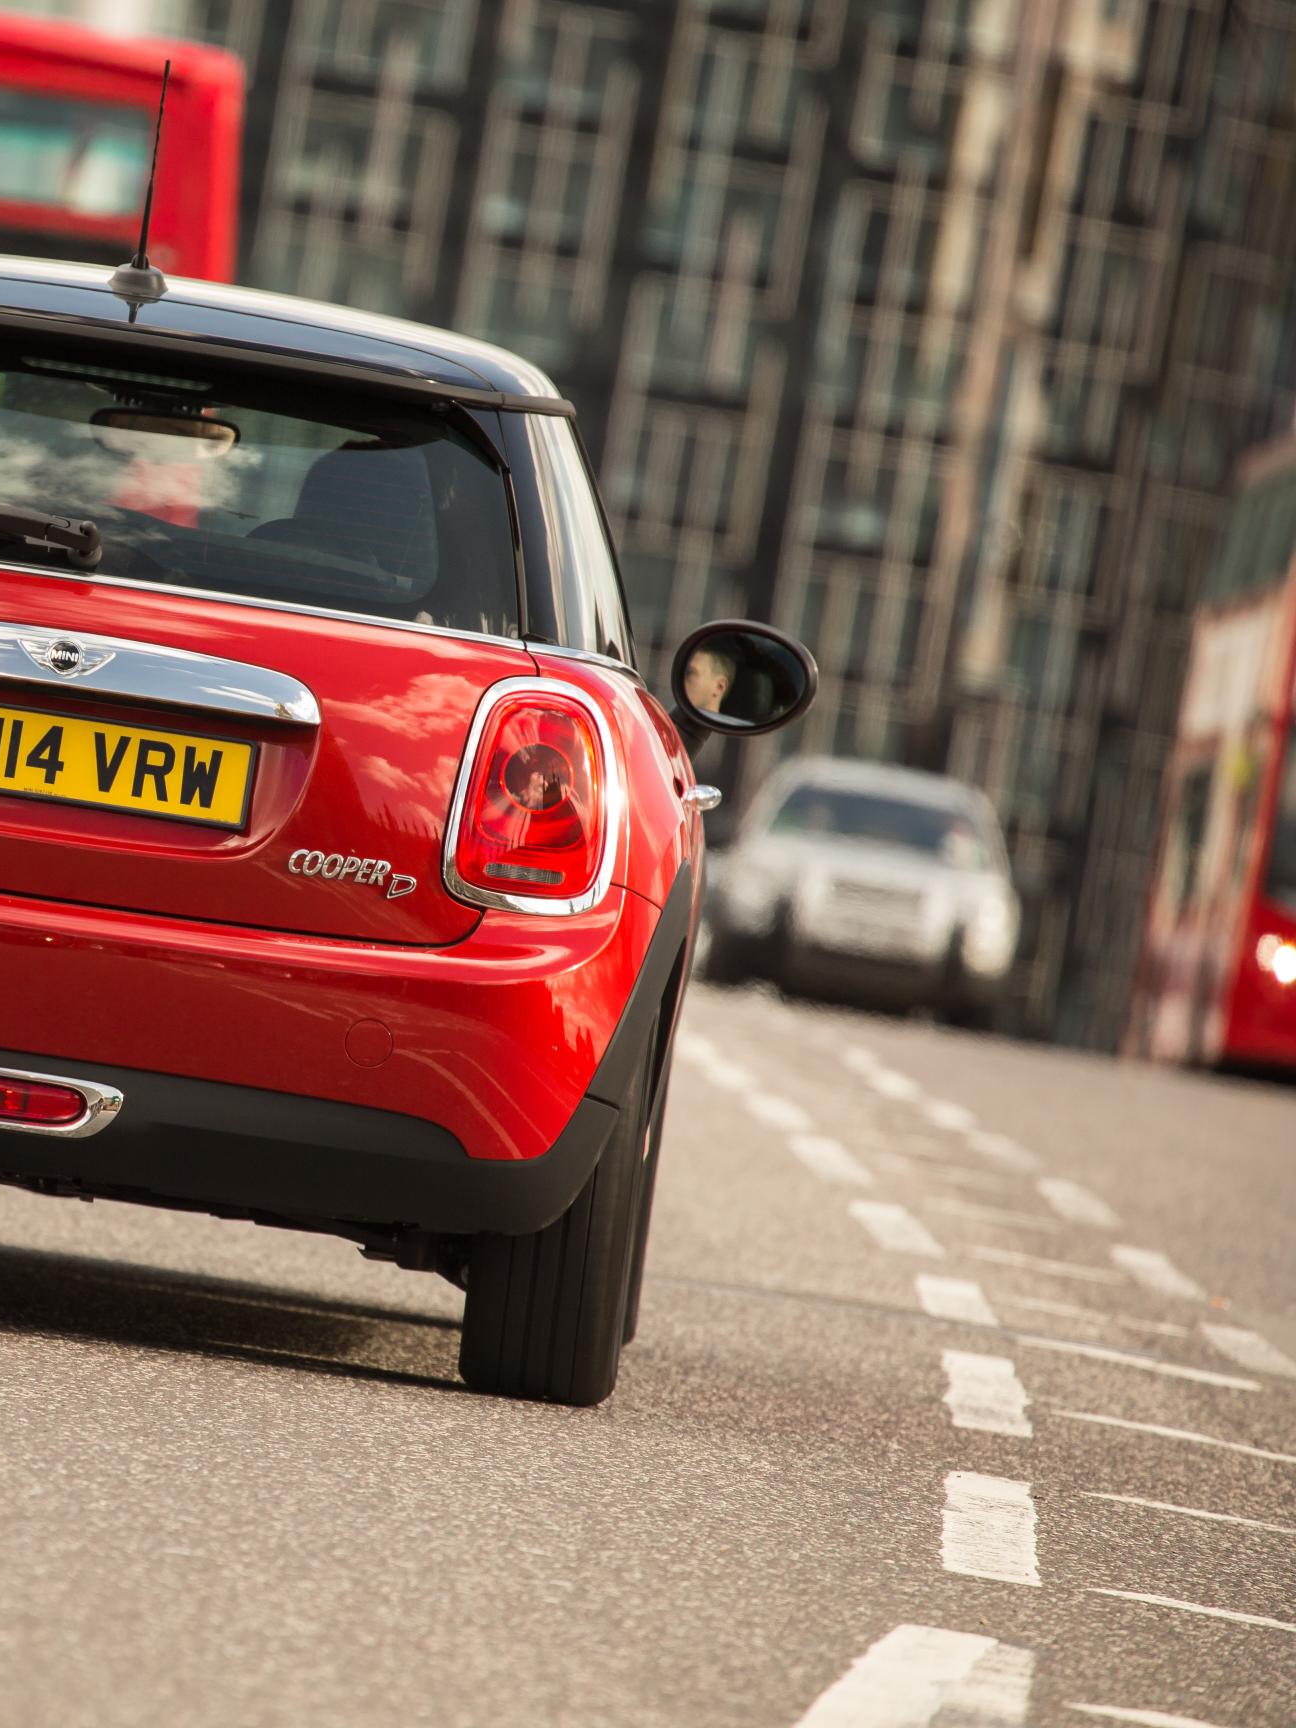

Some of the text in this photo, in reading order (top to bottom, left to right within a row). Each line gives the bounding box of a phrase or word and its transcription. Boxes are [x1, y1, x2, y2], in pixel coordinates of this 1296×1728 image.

[50, 649, 79, 662] MINI
[94, 731, 224, 809] VRW
[288, 849, 417, 900] COOPER D
